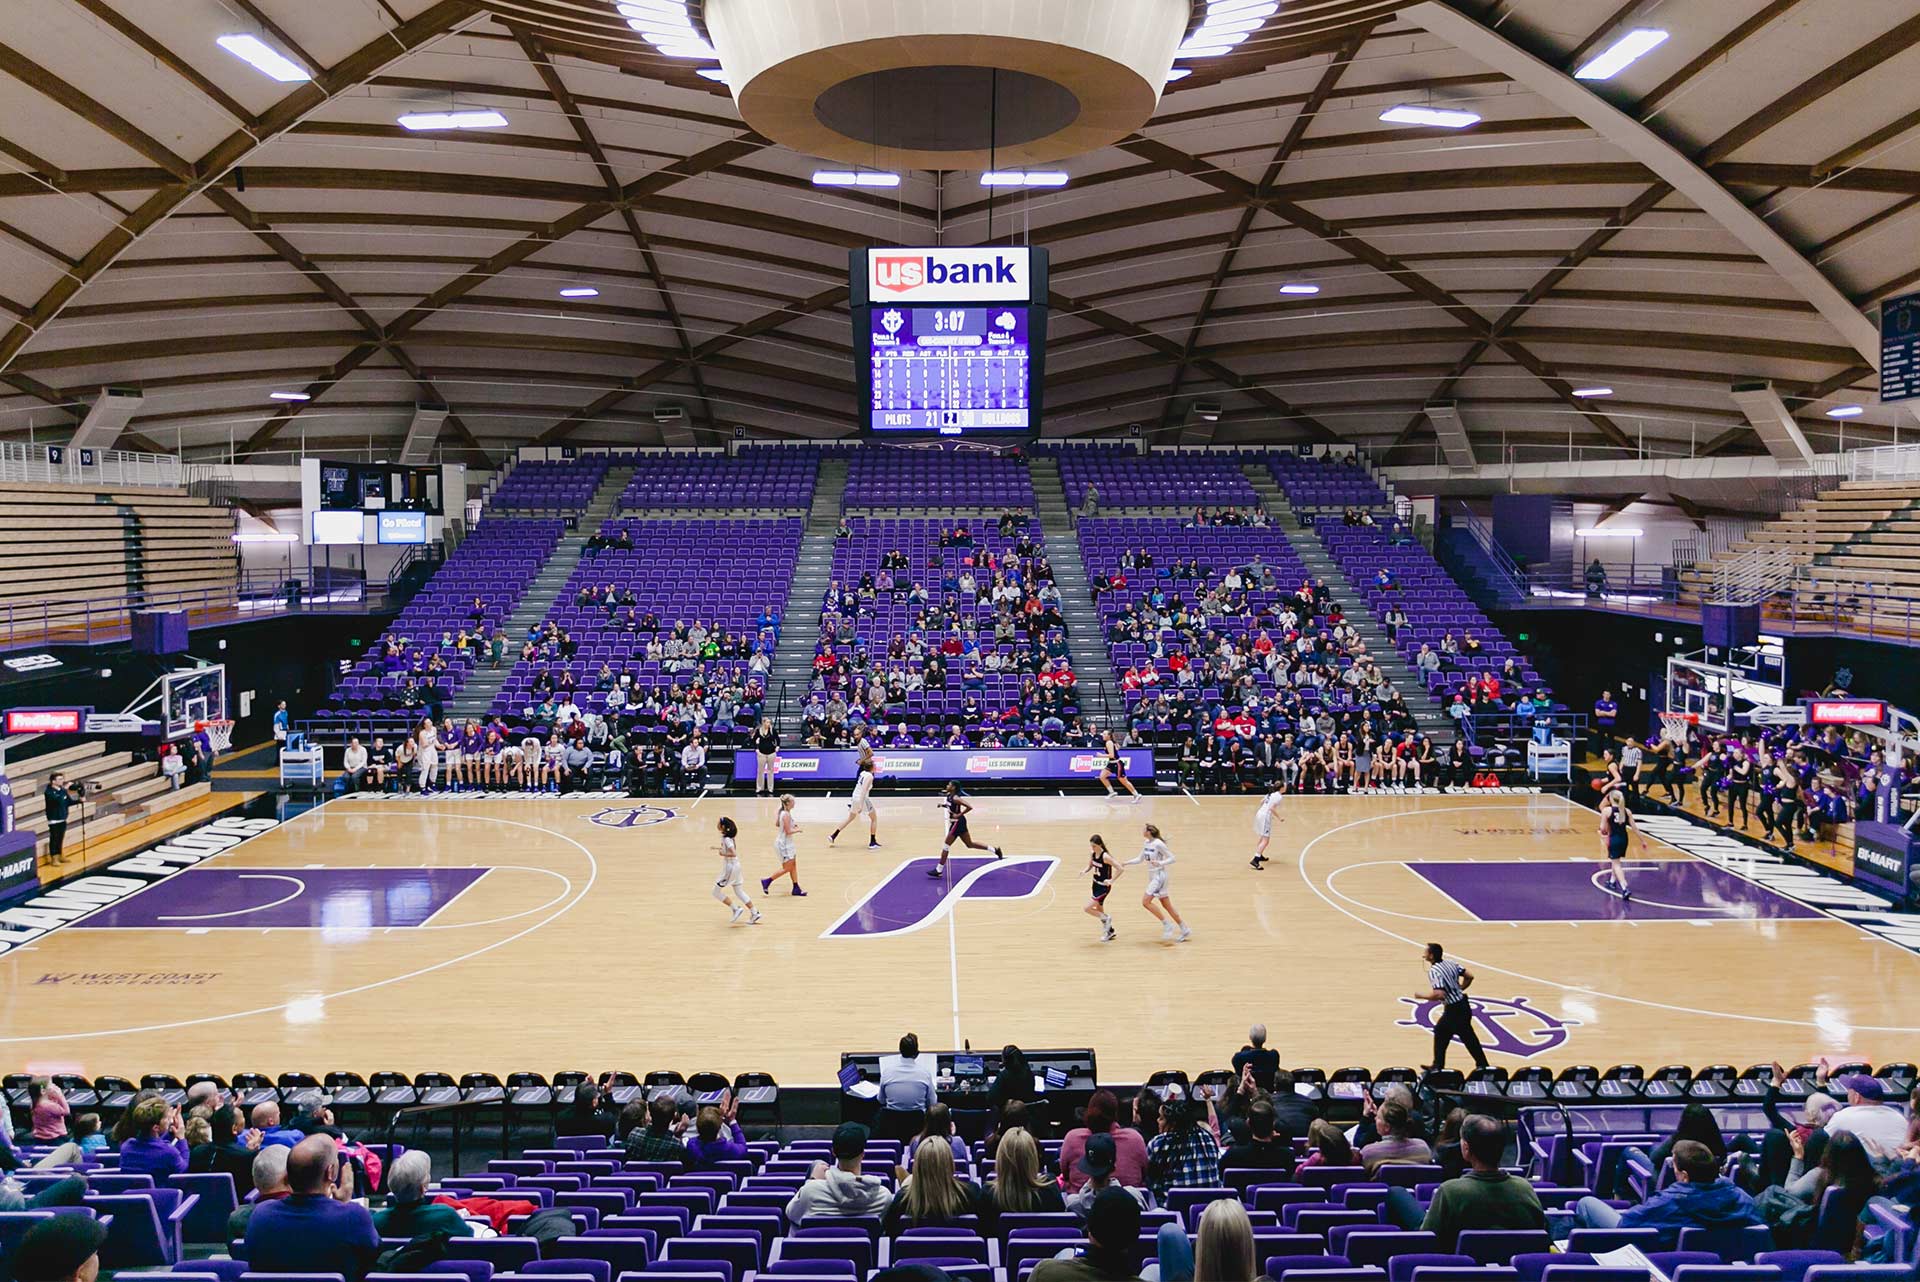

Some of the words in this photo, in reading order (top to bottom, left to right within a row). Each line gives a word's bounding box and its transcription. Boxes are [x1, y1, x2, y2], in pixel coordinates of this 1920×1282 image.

[927, 256, 1017, 284] bank
[934, 311, 965, 331] 3:07
[885, 413, 912, 425] PILOTS
[925, 411, 938, 426] 21
[735, 428, 743, 436] 12
[52, 450, 58, 461] 9
[82, 452, 91, 463] 10
[382, 518, 395, 528] Go
[999, 760, 1024, 768] SCHWAB
[107, 816, 281, 875] PILOTS
[1857, 847, 1902, 872] BI-MART
[81, 972, 147, 980] WEST
[148, 972, 224, 980] COAST
